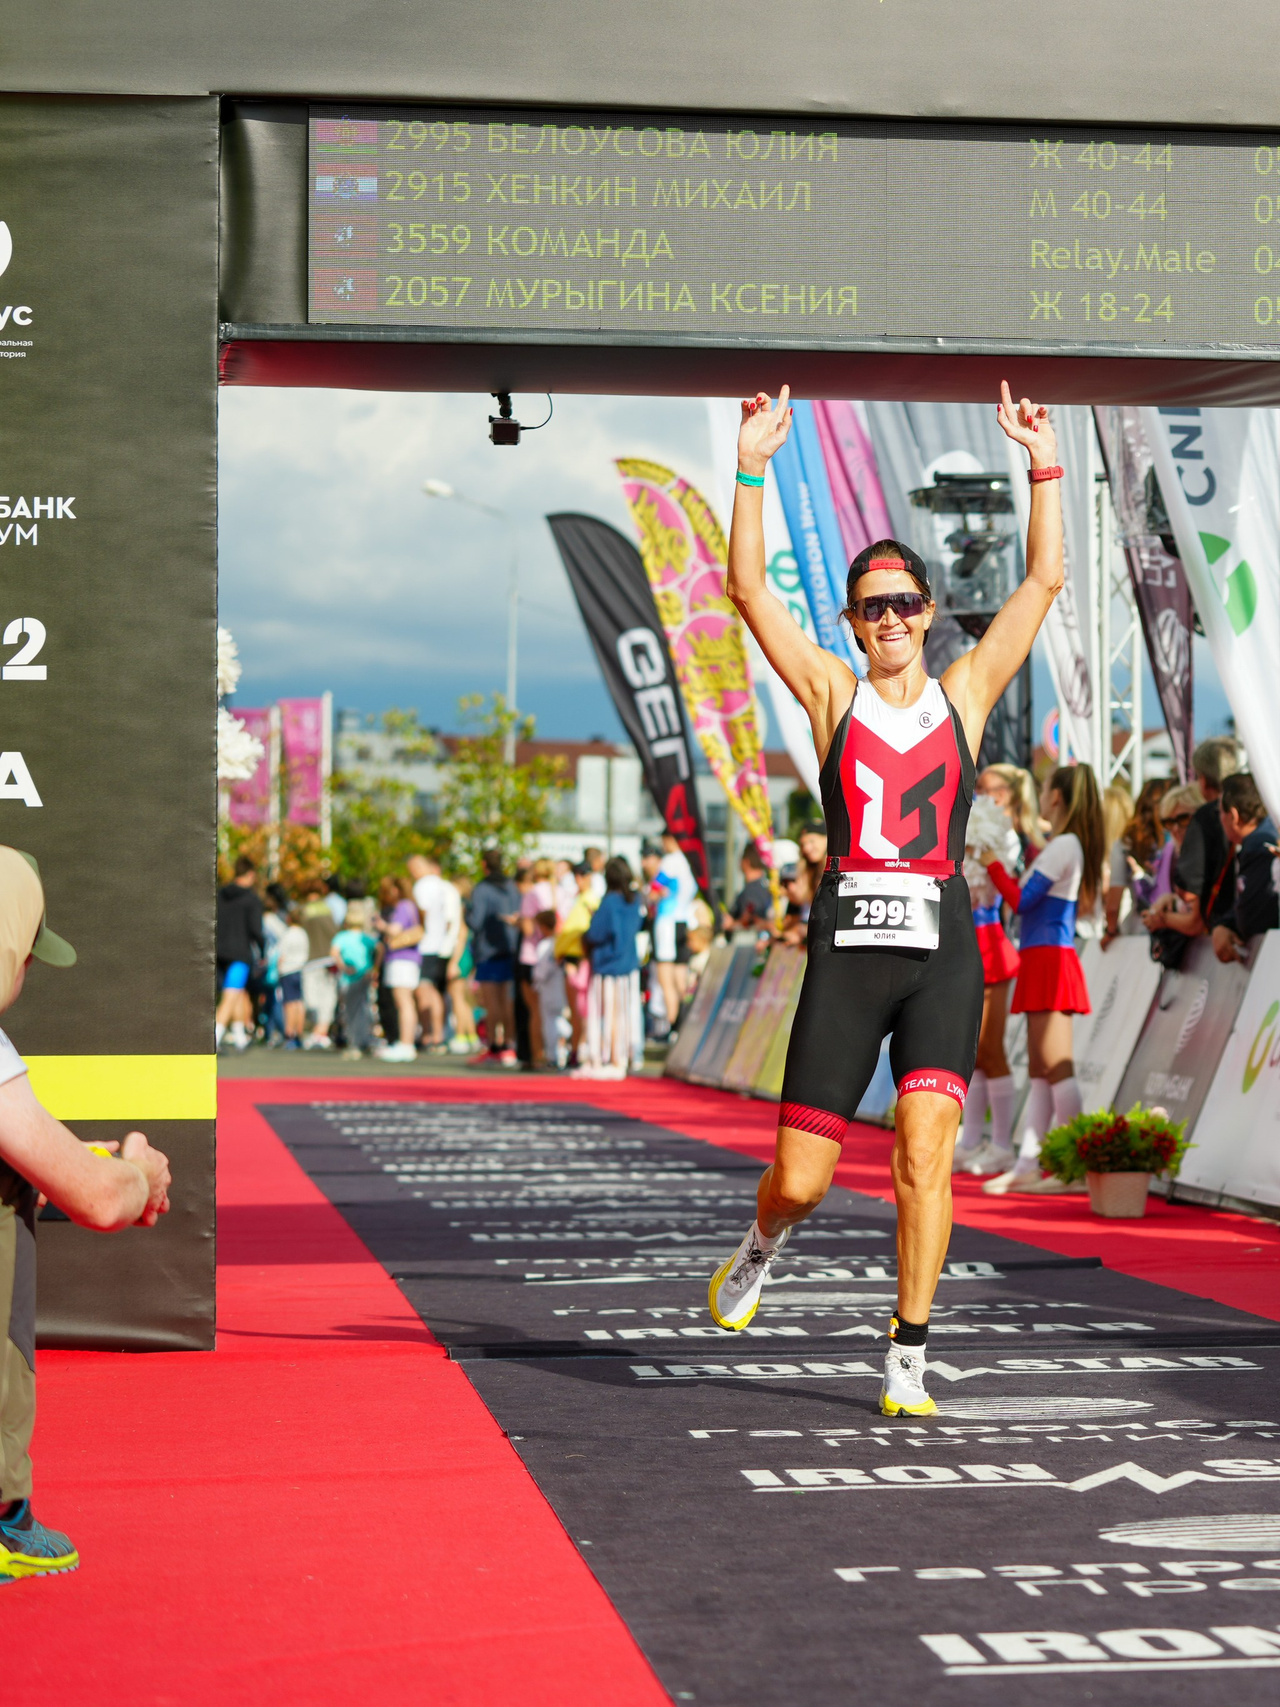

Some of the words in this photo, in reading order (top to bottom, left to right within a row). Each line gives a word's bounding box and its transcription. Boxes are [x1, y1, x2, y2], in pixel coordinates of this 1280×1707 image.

[386, 120, 472, 151] 2995
[487, 123, 711, 160] БЕЛОУСОВА
[726, 129, 839, 163] ЮЛИЯ
[1029, 138, 1064, 169] Ж
[1077, 140, 1174, 172] 40-44
[385, 171, 472, 203] 2915
[487, 173, 638, 208] ХЕНКИН
[652, 178, 813, 211] МИХАИЛ
[1029, 188, 1058, 219] М
[1070, 190, 1169, 221] 40-44
[386, 223, 472, 254] 3559
[487, 225, 675, 267] КОМАНДА
[1030, 239, 1217, 279] Relay.Male
[385, 275, 472, 307] 2057
[487, 278, 697, 313] МУРЫГИНА
[711, 282, 859, 317] КСЕНИЯ
[1029, 290, 1063, 321] Ж
[1080, 292, 1175, 323] 18-24
[0, 340, 34, 348] альная
[853, 899, 918, 927] 2995
[874, 932, 896, 940] ЮЛИЯ
[904, 1078, 938, 1091] TEAM
[584, 1325, 810, 1340] IRON
[928, 1321, 1156, 1334] STAR
[628, 1362, 880, 1377] IRON
[996, 1356, 1261, 1371] STAR
[738, 1463, 1059, 1487] IRON
